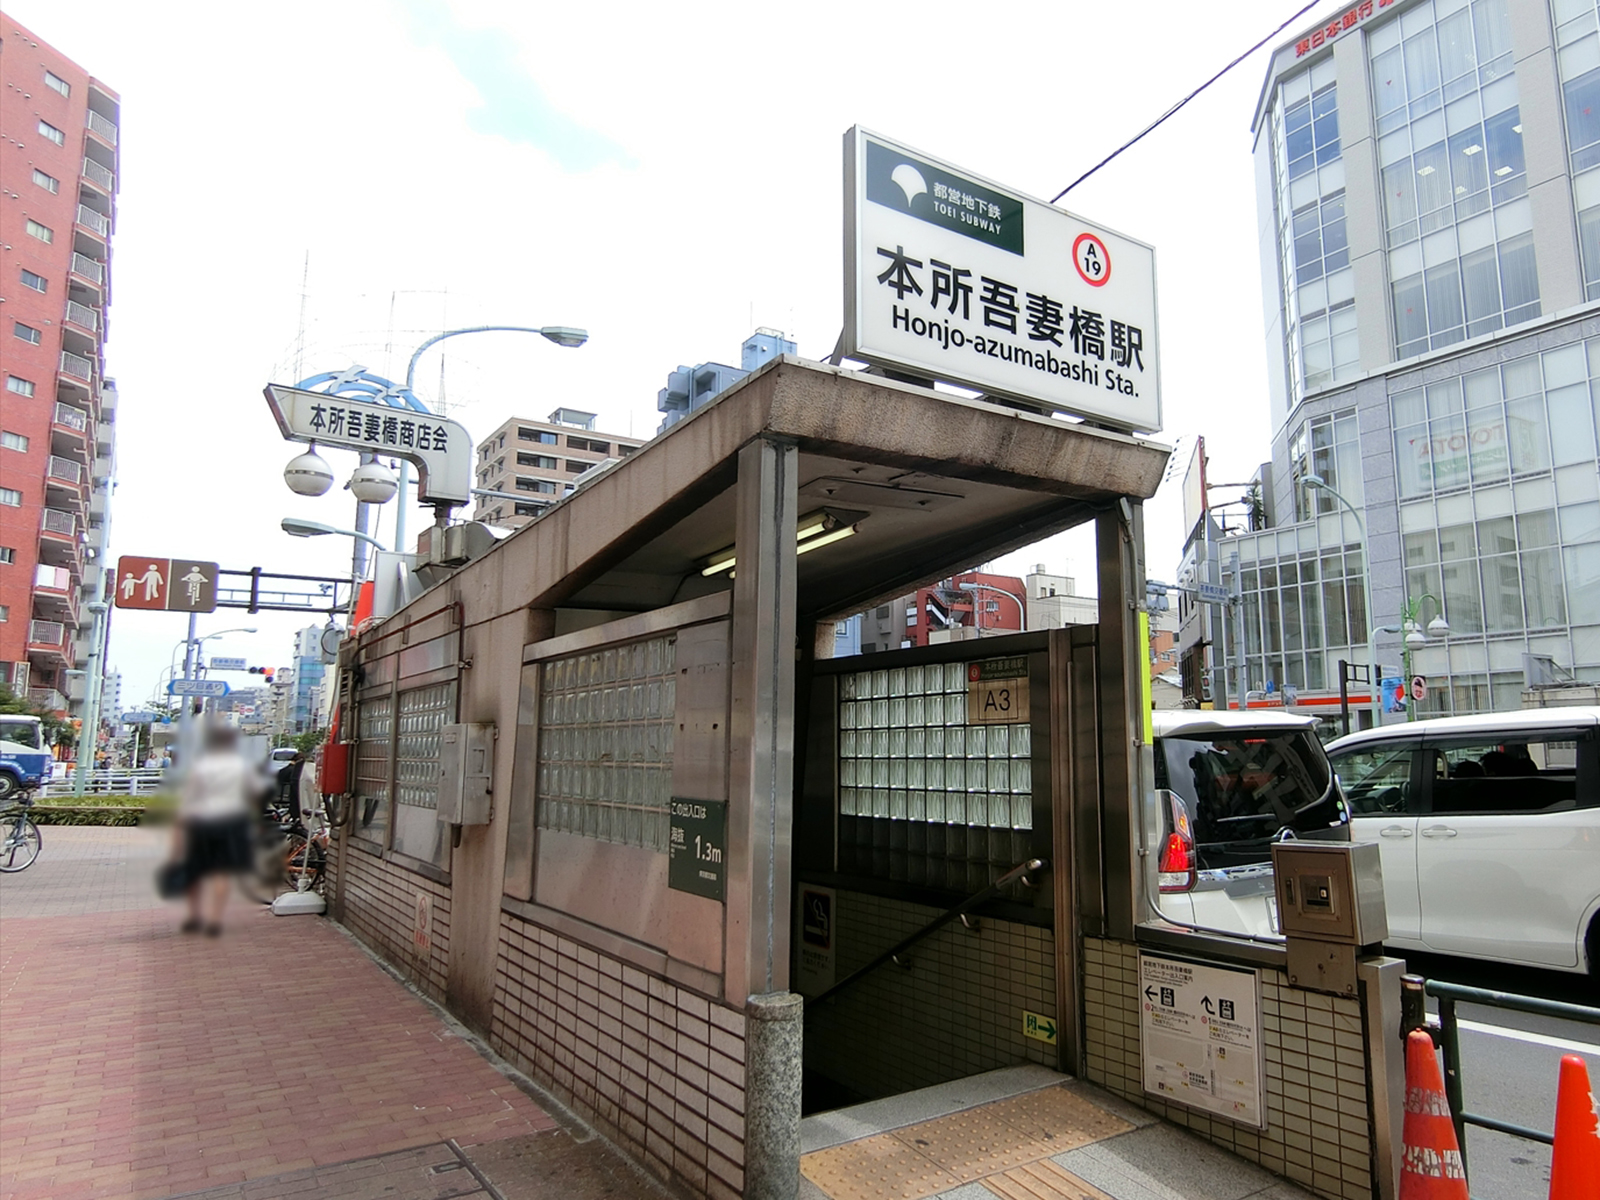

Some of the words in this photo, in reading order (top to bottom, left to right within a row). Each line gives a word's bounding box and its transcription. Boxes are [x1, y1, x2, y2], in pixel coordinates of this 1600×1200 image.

[1295, 0, 1373, 57] 東日本銀行
[933, 181, 1002, 221] 都営地下鉄
[933, 201, 957, 218] TOEI
[960, 209, 1002, 235] SUBWAY
[1086, 243, 1098, 258] A
[1084, 257, 1102, 279] 19
[876, 245, 1144, 372] 本所吾妻橋駅
[892, 304, 1100, 386] Honjo-azumabashi
[1105, 372, 1140, 398] Sta.
[309, 403, 449, 454] 本所吾妻橋商店会
[177, 682, 223, 691] 三ツ目通り
[984, 689, 1011, 712] A3
[671, 802, 706, 818] この出入口は
[695, 835, 722, 864] 1.3m
